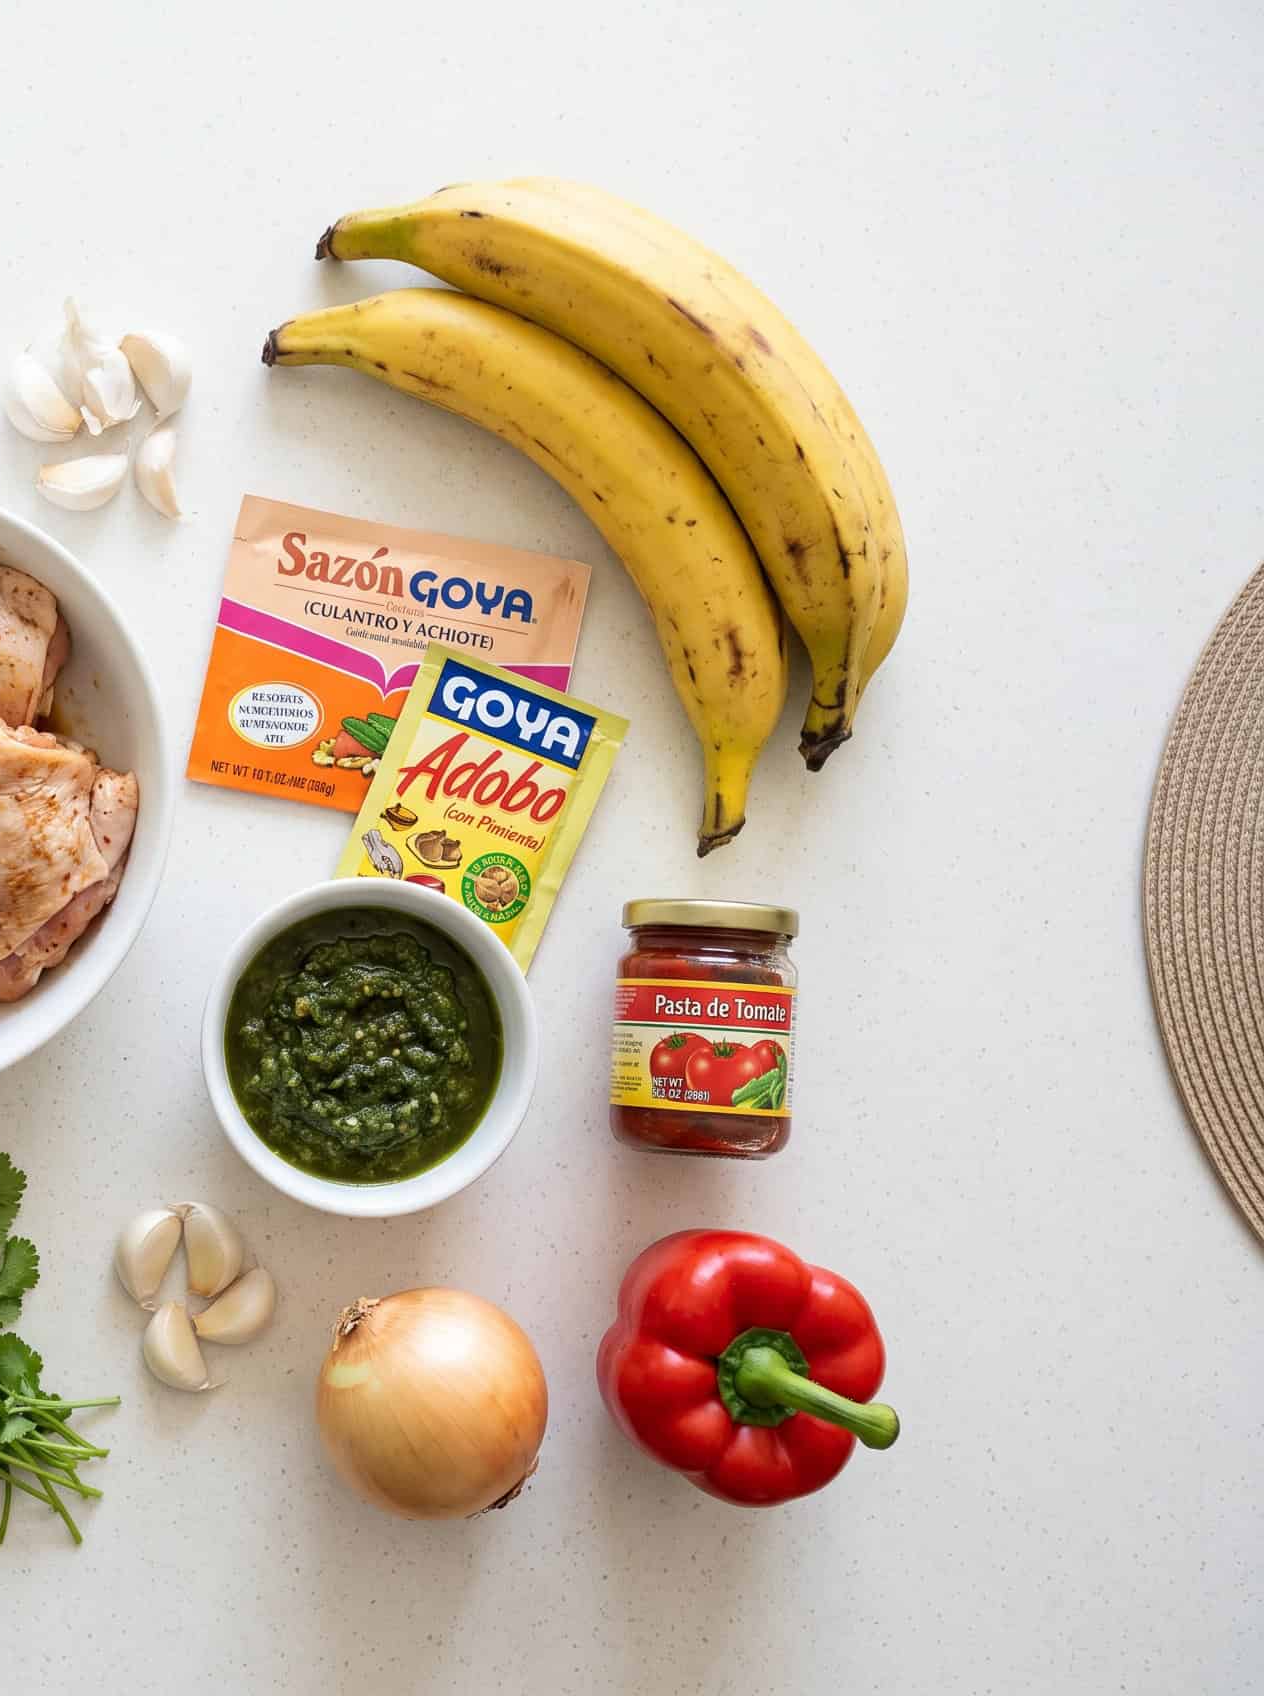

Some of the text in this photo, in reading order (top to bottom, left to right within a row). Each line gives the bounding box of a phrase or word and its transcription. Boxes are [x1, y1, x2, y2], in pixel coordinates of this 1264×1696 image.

[277, 532, 532, 623] Sazón GOYA
[304, 600, 398, 631] (CULANTRO
[403, 619, 413, 633] Y
[416, 623, 494, 651] ACHIOTE)
[442, 674, 580, 760] GOYA
[210, 759, 230, 774] NET
[233, 764, 248, 777] WT
[396, 731, 567, 823] Adobo
[443, 802, 473, 828] (con
[654, 994, 701, 1017] Pasta
[706, 998, 728, 1018] de
[734, 998, 787, 1023] Tomate
[652, 1076, 684, 1088] NET WT
